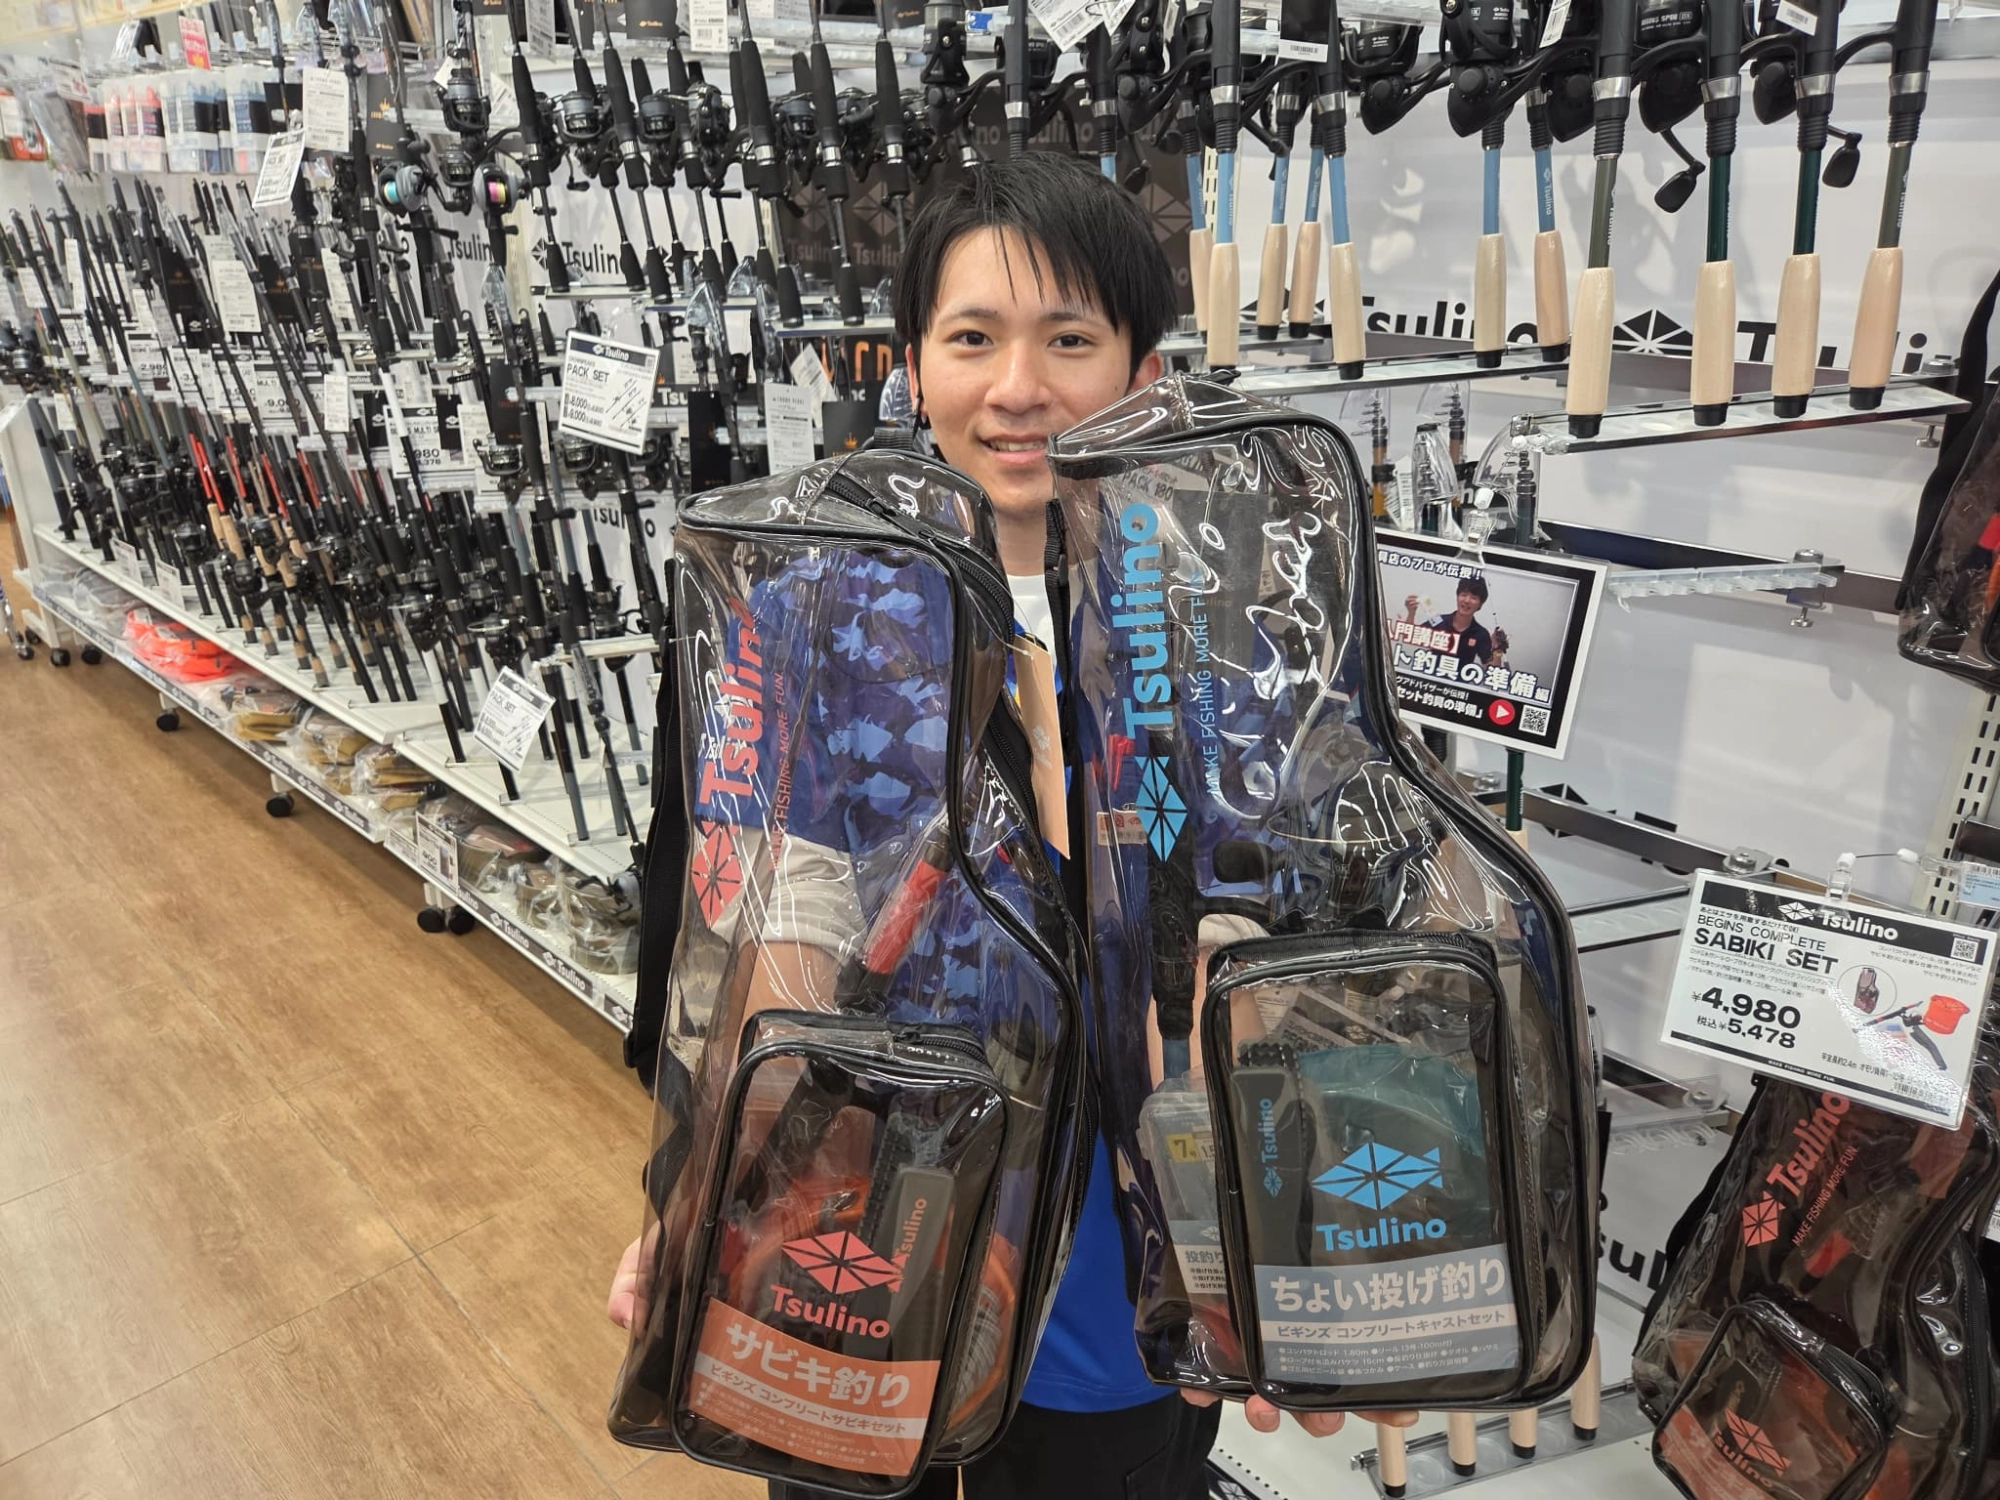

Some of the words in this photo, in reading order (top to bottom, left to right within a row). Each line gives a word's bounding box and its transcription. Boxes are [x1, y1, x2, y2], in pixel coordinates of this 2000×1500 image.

[561, 241, 621, 275] Tsulin
[566, 363, 589, 379] PACK
[593, 369, 610, 383] SET
[605, 346, 630, 361] Tsulino
[1155, 482, 1174, 501] 180
[1111, 502, 1174, 741] Tsulino
[1194, 613, 1212, 664] MORE
[1199, 670, 1217, 742] FISHING
[778, 709, 789, 757] MORE
[502, 919, 530, 949] Tsulino
[1697, 914, 1744, 934] BEGINS
[1750, 926, 1827, 952] COMPLETE
[1820, 909, 1899, 942] Tsulino
[556, 959, 586, 991] Tsulino
[1694, 928, 1776, 961] SABIKI
[1785, 948, 1839, 975] SET
[1691, 986, 1801, 1029] ¥4,980
[1719, 1018, 1796, 1049] ¥5,478
[1258, 1097, 1279, 1163] Tsulino
[1766, 1091, 1851, 1197] Tsulino
[893, 1197, 928, 1260] Tsulino
[1792, 1222, 1812, 1248] MAKE
[1807, 1186, 1832, 1227] FISHING
[1827, 1163, 1847, 1192] MORE
[1316, 1216, 1447, 1252] Tsulino
[1270, 1257, 1506, 1314] ちょい投げ釣り
[769, 1284, 891, 1339] Tsulino
[1278, 1323, 1331, 1340] ビギンズ
[1336, 1309, 1506, 1339] コンプリートキャストセット
[725, 1321, 911, 1408] サビキ釣り
[709, 1364, 758, 1398] ビギンズ
[760, 1386, 908, 1435] コンプリートサビキセット
